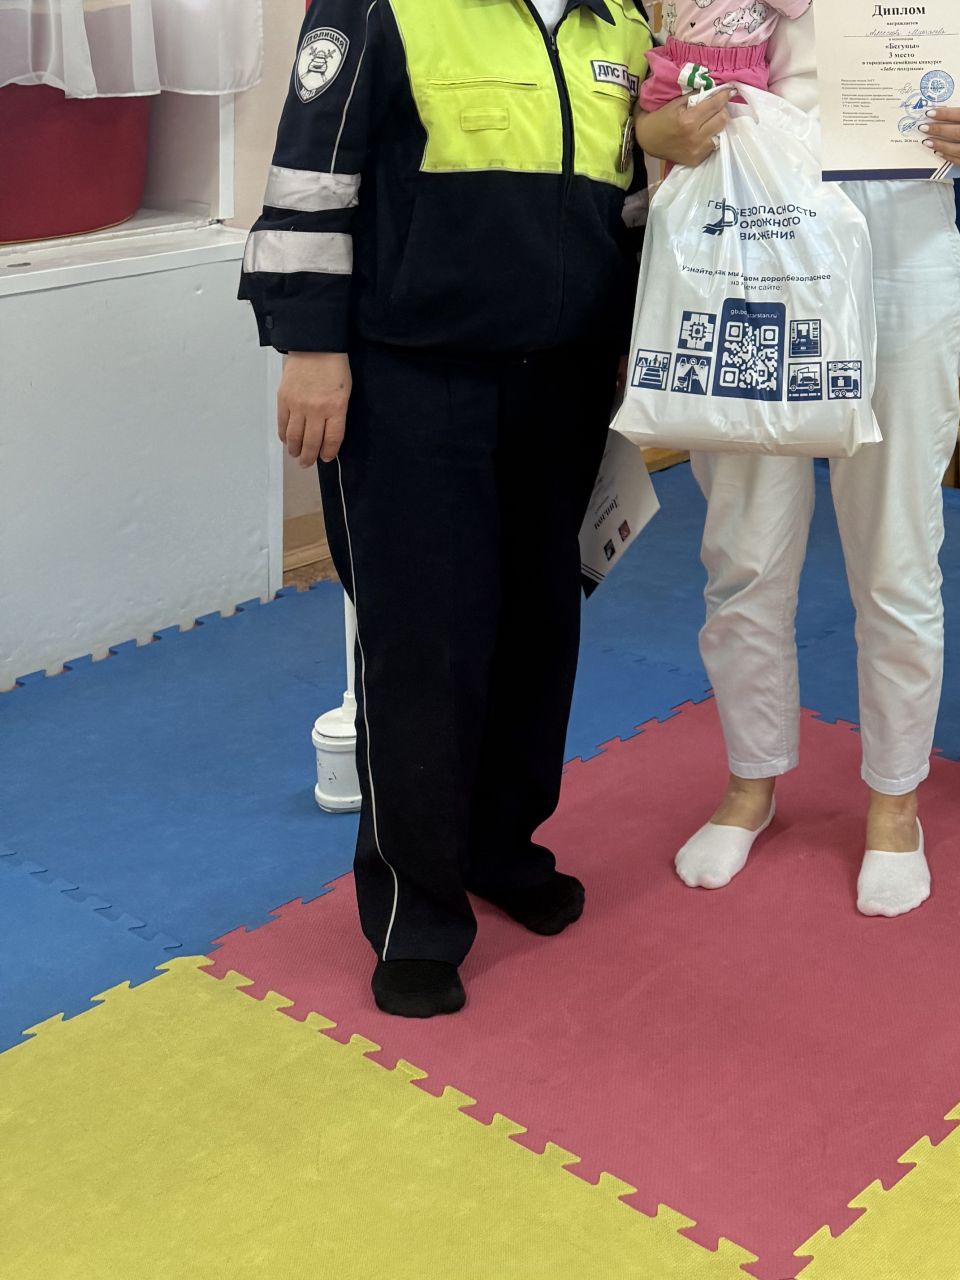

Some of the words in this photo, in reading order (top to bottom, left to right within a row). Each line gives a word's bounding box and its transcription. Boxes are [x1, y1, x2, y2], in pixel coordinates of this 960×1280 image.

[872, 4, 926, 18] Диплом
[305, 31, 344, 50] ПОЛИЦИЯ
[597, 64, 621, 79] ДПС
[736, 204, 817, 218] ЕЗОПАСНОСТЬ
[739, 216, 801, 229] ОРОЖНОГО
[739, 230, 796, 241] ВИЖЕНИЯ
